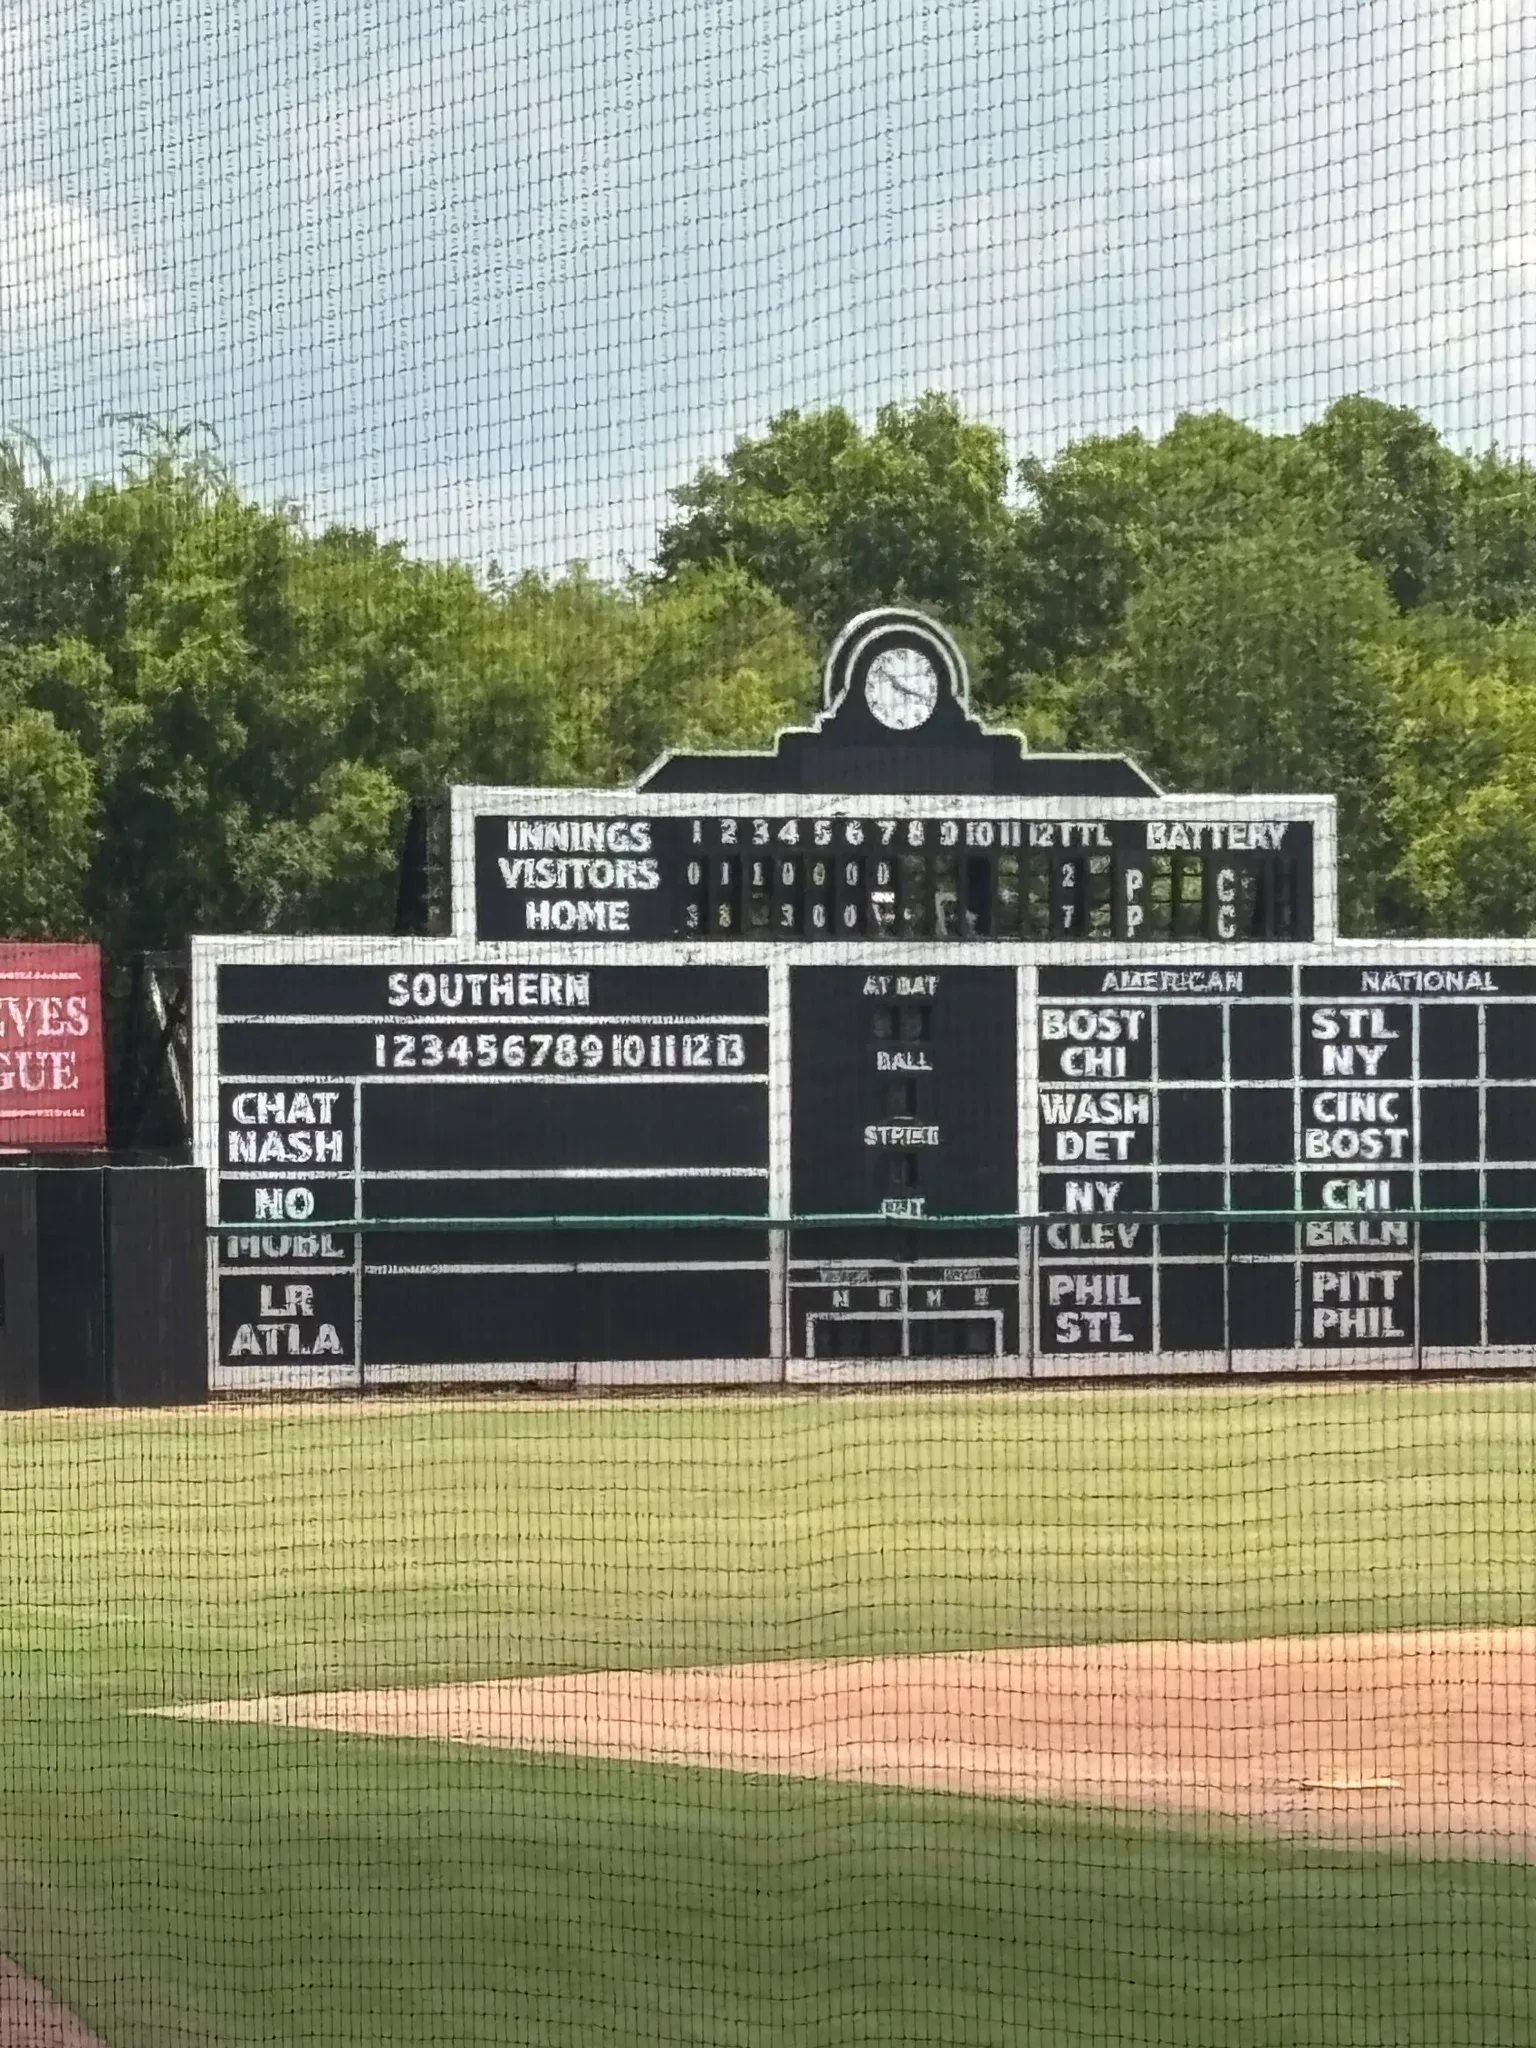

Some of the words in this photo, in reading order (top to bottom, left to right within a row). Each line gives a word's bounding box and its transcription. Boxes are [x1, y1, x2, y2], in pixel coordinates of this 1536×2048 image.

[508, 821, 651, 852] INNINGS
[692, 819, 702, 844] 1
[720, 819, 738, 844] 2
[752, 819, 770, 845] 3
[777, 819, 800, 845] 4
[814, 820, 832, 846] 5
[845, 820, 864, 846] 6
[876, 820, 898, 846] 7
[907, 820, 926, 847] 8
[966, 822, 995, 847] 10
[998, 822, 1021, 847] 11
[1029, 822, 1053, 847] 12
[1147, 820, 1288, 850] BATTERY
[498, 858, 660, 889] VISITORS
[688, 862, 700, 885] 0
[721, 862, 729, 885] 1
[782, 862, 794, 885] 0
[846, 862, 857, 885] 0
[877, 863, 889, 884] 0
[1062, 863, 1075, 888] 2
[1126, 869, 1143, 901] P
[1217, 869, 1234, 901] C
[526, 900, 629, 931] HOME
[813, 905, 825, 927] 0
[844, 905, 856, 927] 0
[1127, 905, 1143, 937] P
[1218, 905, 1235, 938] C
[389, 973, 589, 1007] SOUTHERN
[1102, 971, 1242, 992] AMERICAN
[1362, 971, 1498, 992] NATIONAL
[1042, 1009, 1144, 1041] BOST
[1312, 1008, 1399, 1039] STL
[1061, 1047, 1126, 1077] CHI
[1323, 1045, 1387, 1075] NY
[232, 1092, 339, 1124] CHAT
[1042, 1093, 1149, 1124] WASH
[1313, 1092, 1398, 1122] CINC
[229, 1130, 342, 1162] NASH
[1057, 1131, 1135, 1160] DET
[1306, 1128, 1408, 1159] BOST
[255, 1187, 314, 1219] NO
[1065, 1181, 1122, 1212] NY
[1323, 1179, 1390, 1210] CHI
[1047, 1224, 1139, 1249] CLEV
[260, 1285, 313, 1316] LR
[1049, 1274, 1141, 1305] PHIL
[1313, 1270, 1402, 1302] PITT
[1057, 1312, 1133, 1343] STL
[1314, 1307, 1404, 1338] PHIL
[230, 1324, 343, 1356] ATLA
